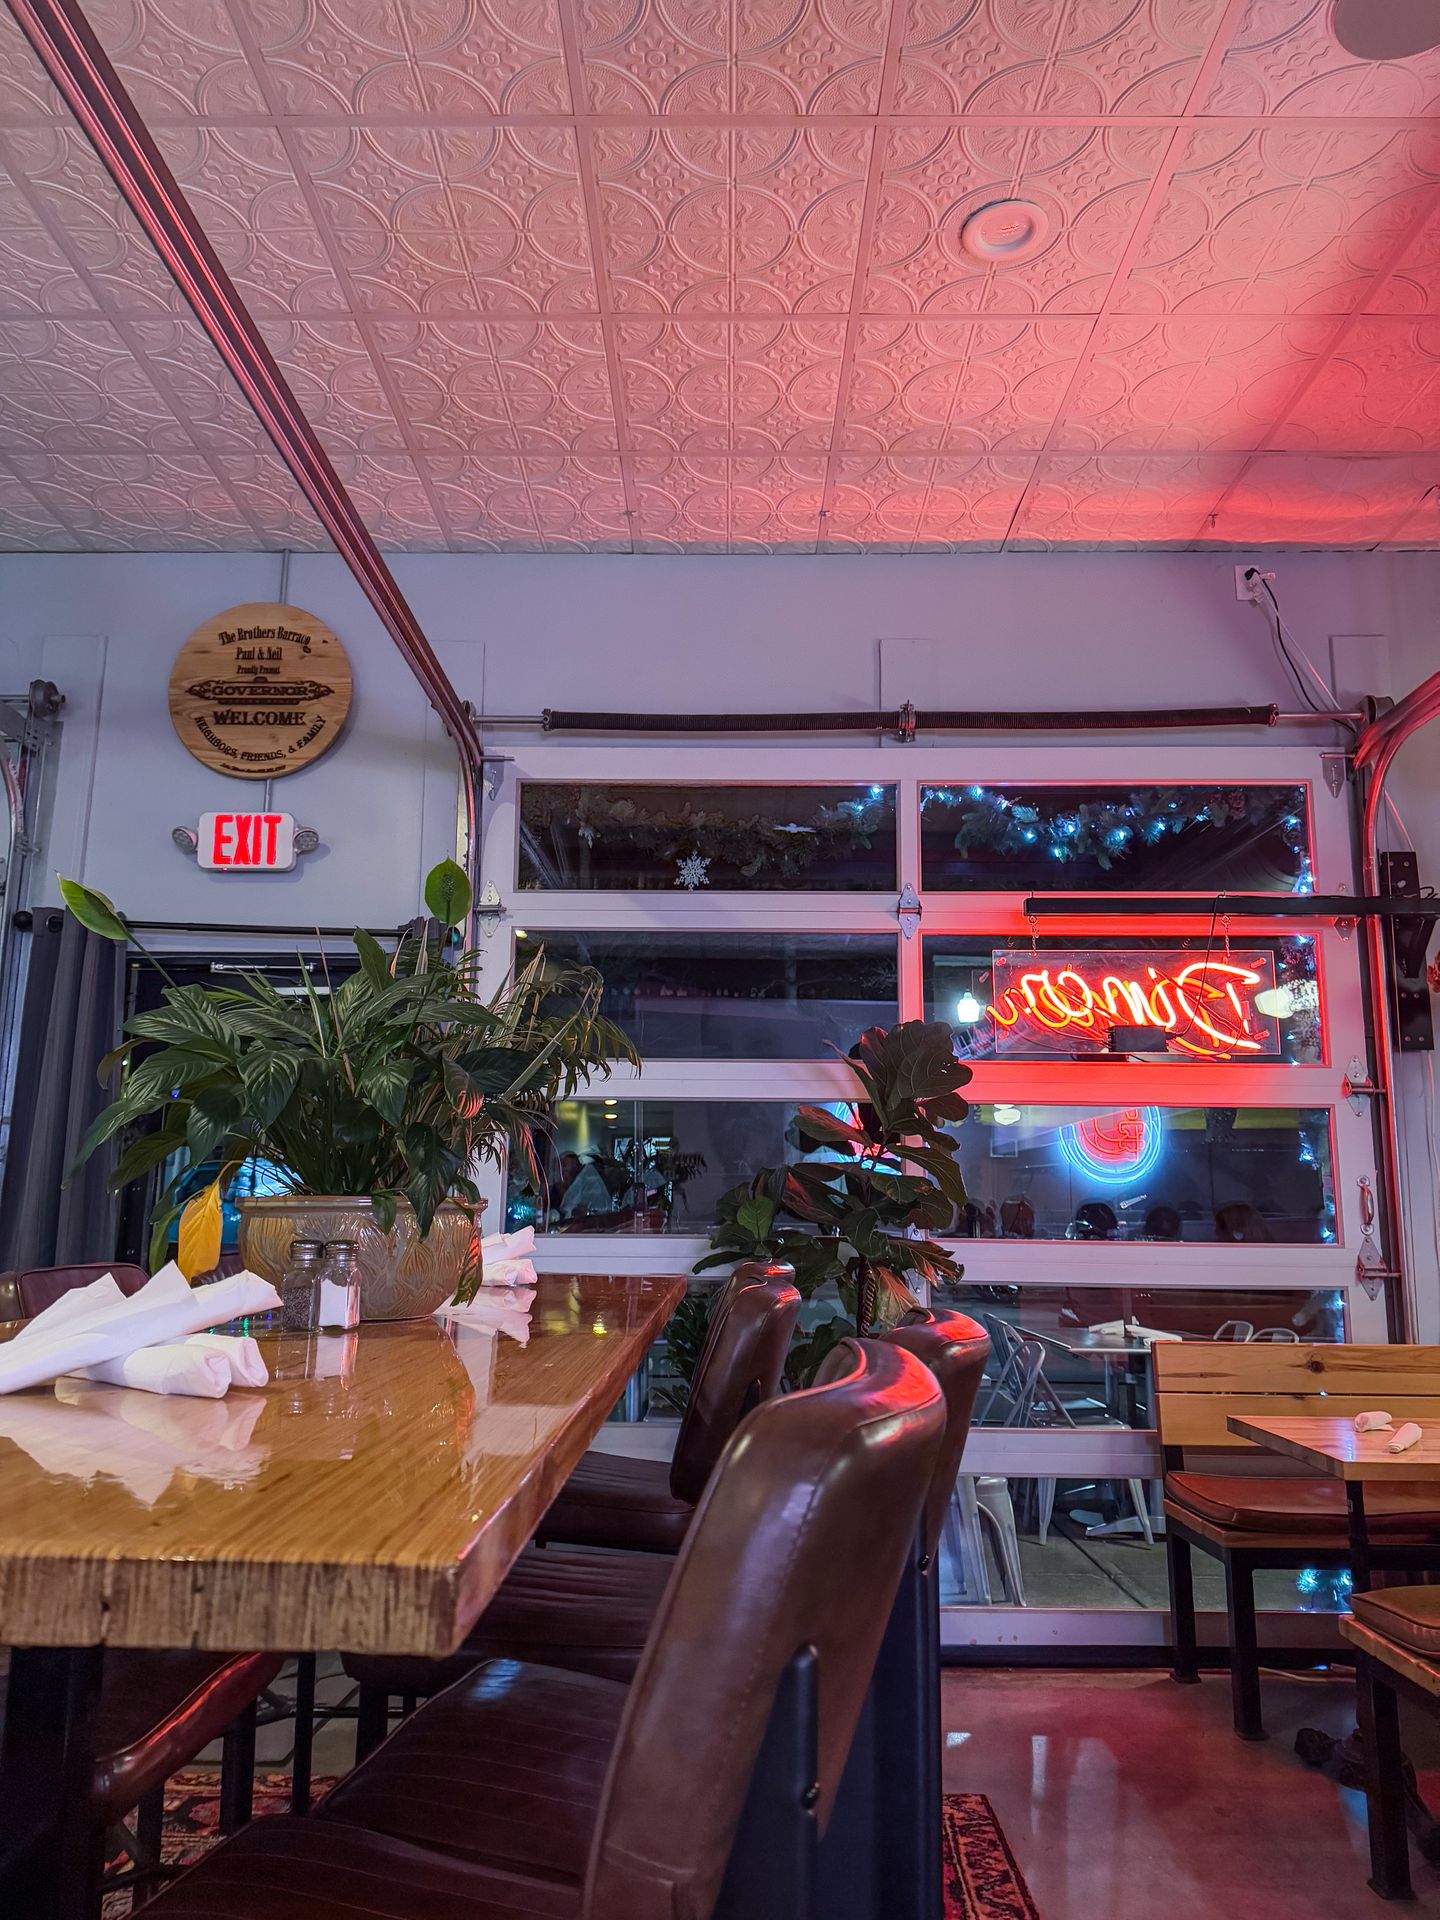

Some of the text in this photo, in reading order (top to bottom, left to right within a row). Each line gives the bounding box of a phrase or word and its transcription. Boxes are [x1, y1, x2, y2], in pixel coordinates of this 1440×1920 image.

[218, 630, 236, 646] The
[237, 626, 275, 641] Brothers
[235, 647, 283, 660] Paul & Neil
[211, 686, 308, 696] GOVERNOR
[212, 709, 307, 726] WELCOME
[194, 715, 326, 762] NEIGHBORS, FRIENDS, & FAMILY
[213, 814, 282, 865] EXIT
